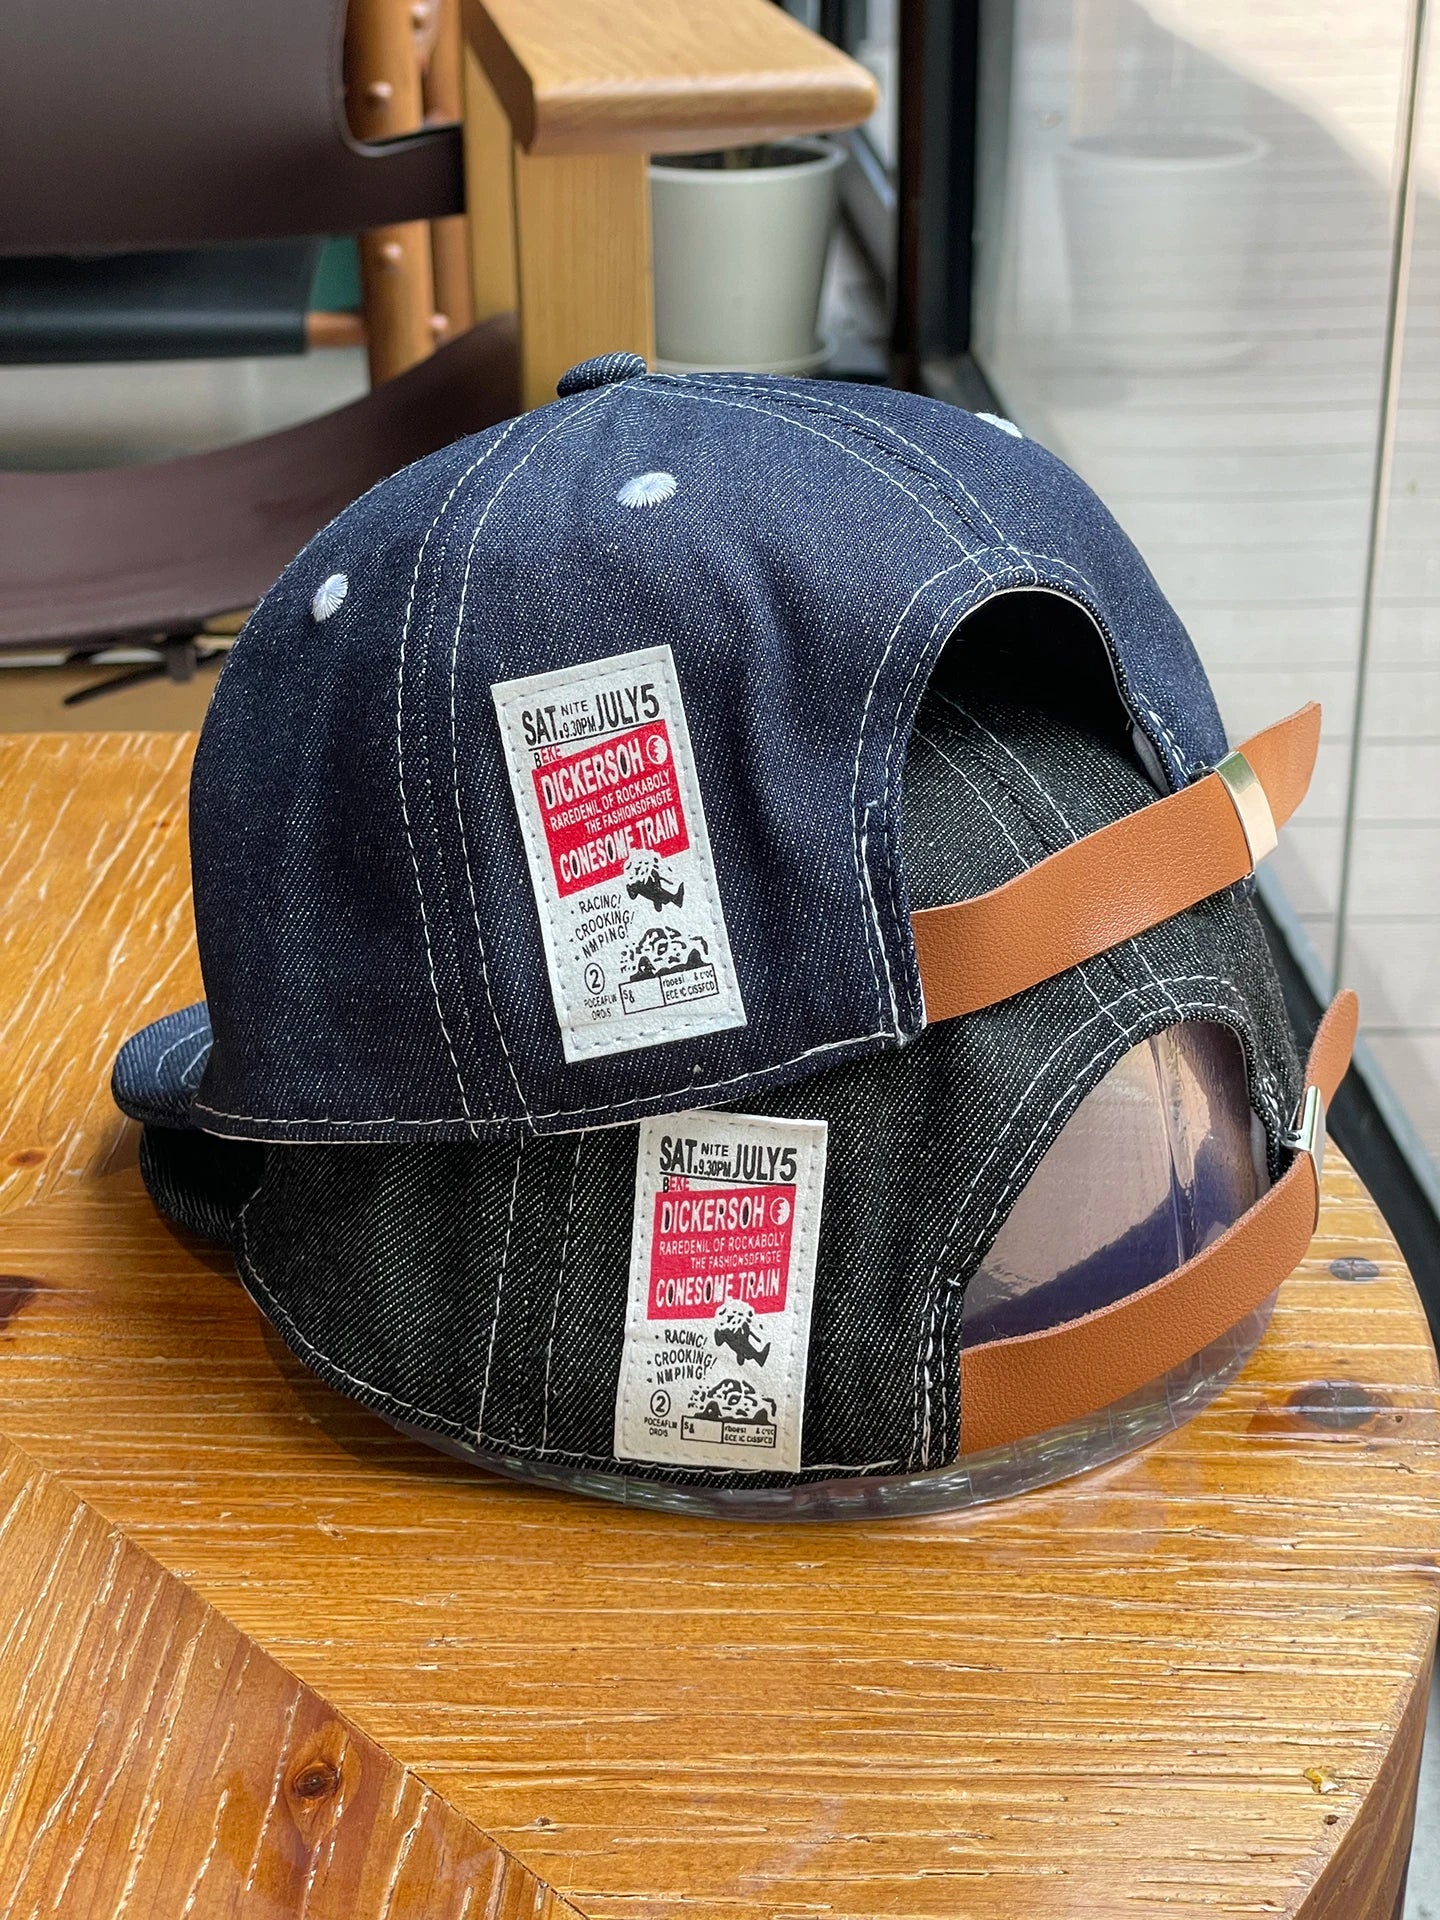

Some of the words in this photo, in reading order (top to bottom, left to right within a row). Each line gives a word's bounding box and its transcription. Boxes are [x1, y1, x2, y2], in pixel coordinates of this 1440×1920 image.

[560, 700, 589, 715] NITE
[563, 715, 596, 739] 9.30PM
[540, 738, 645, 810] DICKERSOH
[601, 793, 614, 811] OF
[585, 816, 602, 835] THE
[636, 806, 679, 852] TRAIN
[701, 1142, 729, 1157] NITE
[698, 1160, 731, 1178] 9.30PM
[660, 1195, 765, 1234] DICKERSOH
[713, 1237, 725, 1252] OF
[691, 1256, 705, 1269] THE
[737, 1268, 780, 1301] TRAIN
